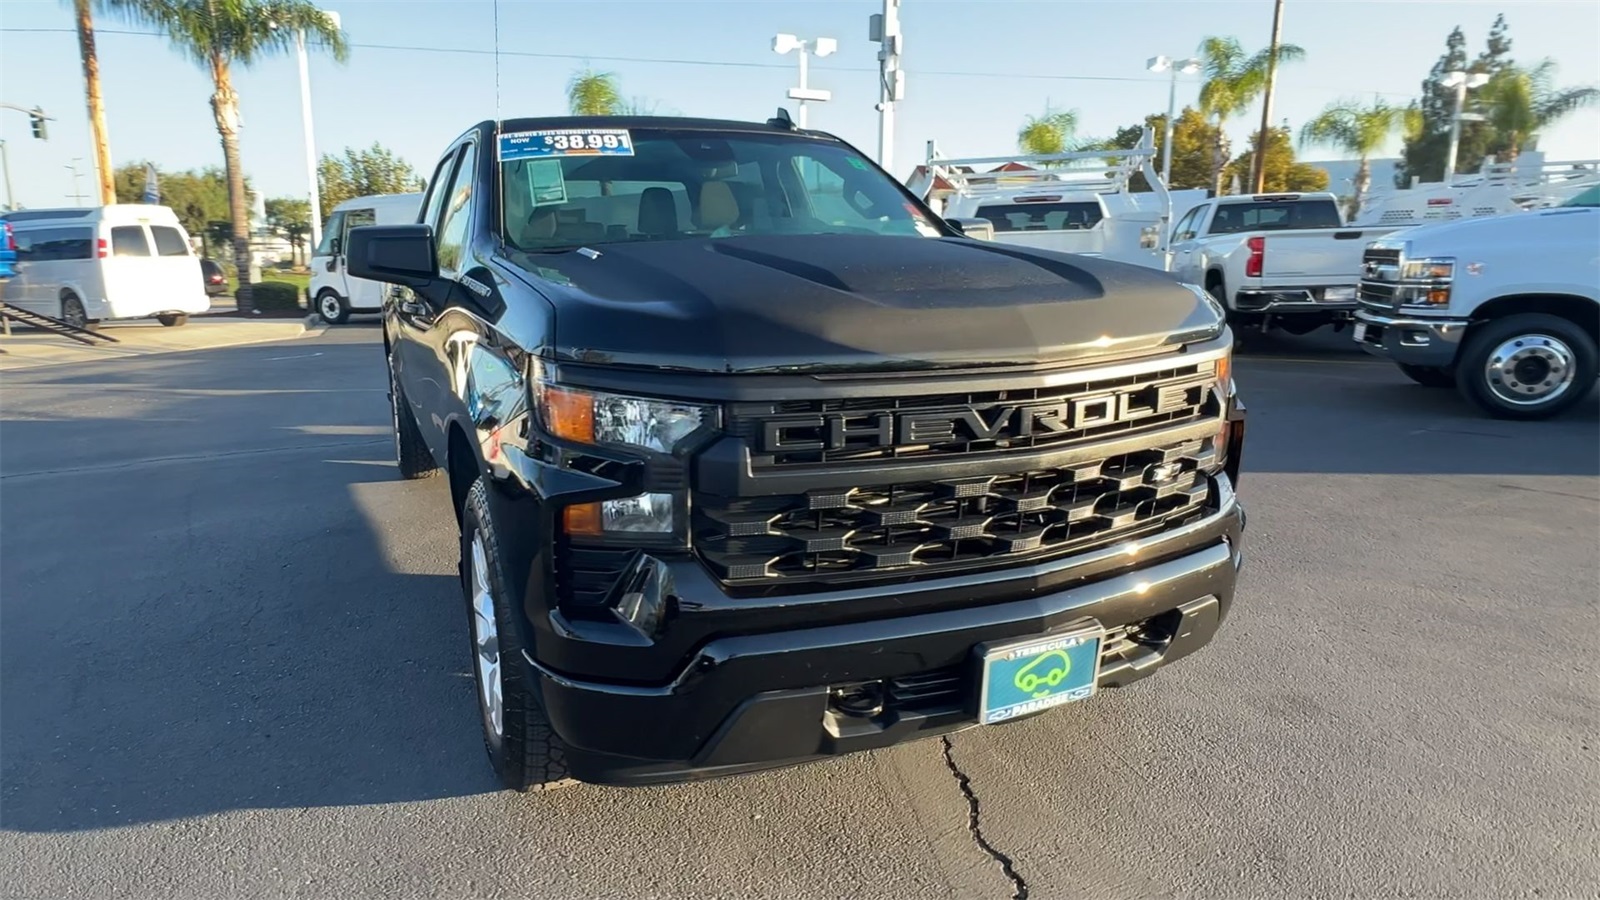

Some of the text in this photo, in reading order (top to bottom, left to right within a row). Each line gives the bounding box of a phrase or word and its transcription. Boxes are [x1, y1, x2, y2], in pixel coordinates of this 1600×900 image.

[763, 383, 1214, 451] CHEVROLET
[1015, 638, 1077, 656] TEMECULA
[1011, 694, 1069, 716] PARADISE
